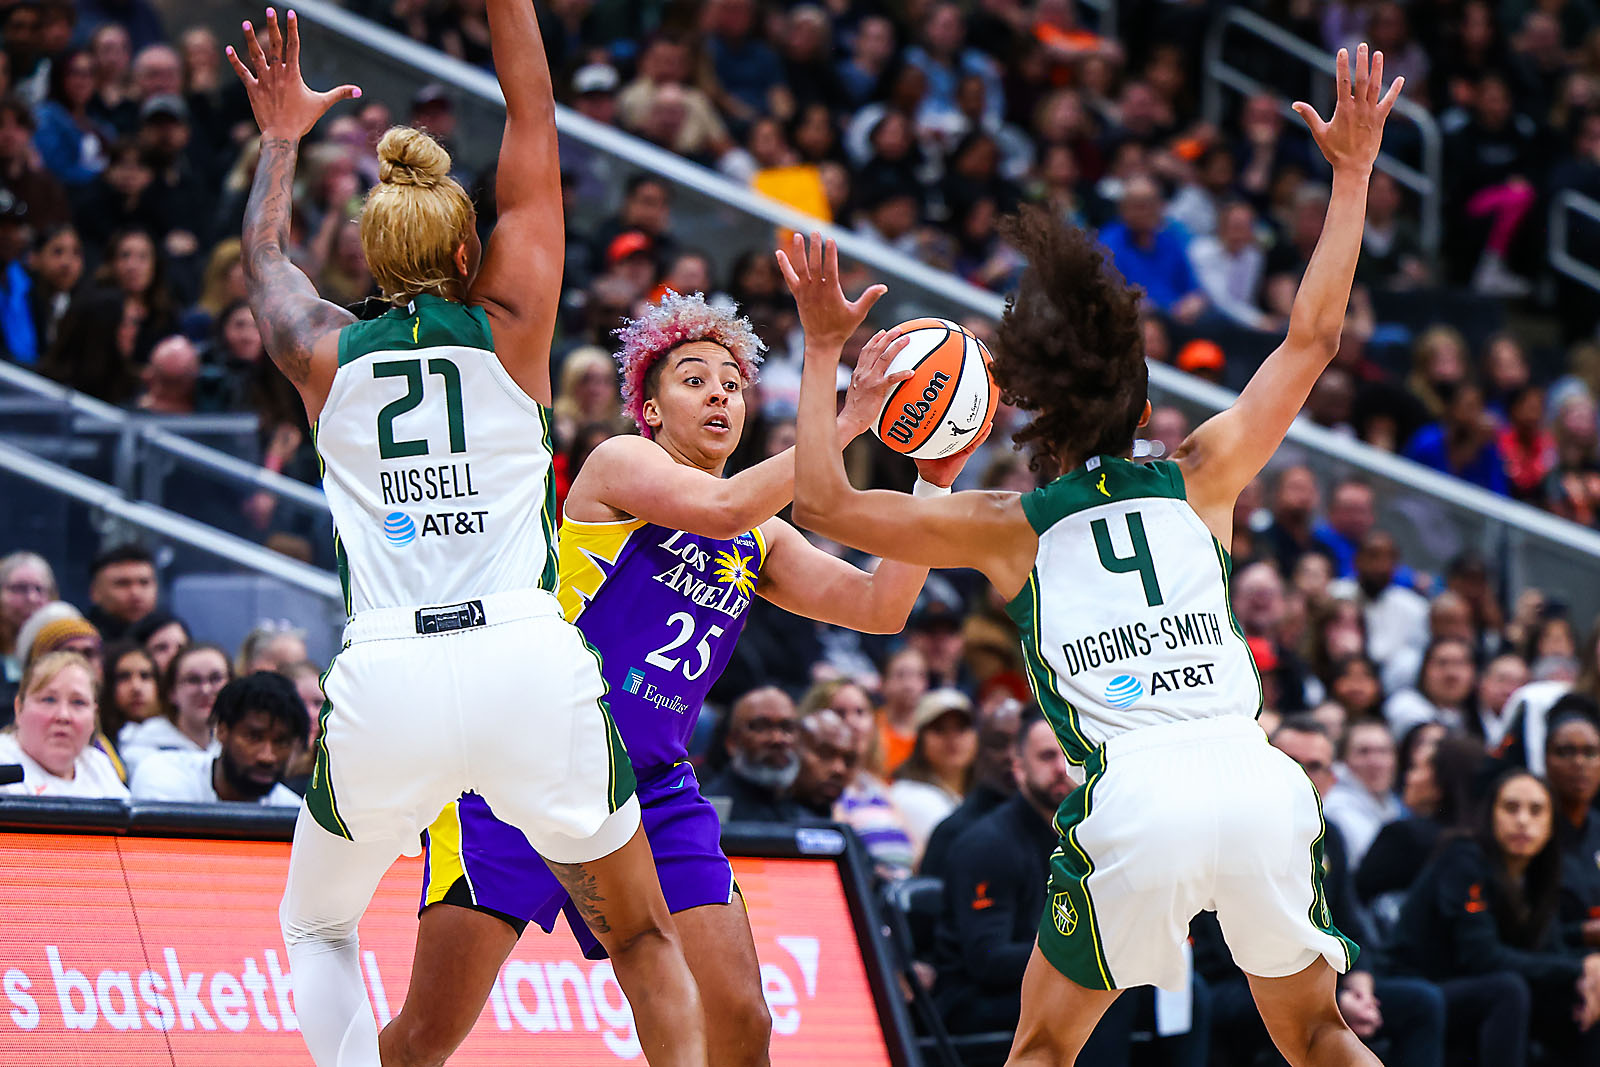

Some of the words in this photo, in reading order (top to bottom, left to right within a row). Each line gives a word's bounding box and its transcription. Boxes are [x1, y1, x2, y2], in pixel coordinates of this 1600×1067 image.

[373, 358, 467, 459] 21
[887, 370, 951, 444] Wilson
[380, 463, 479, 504] RUSSELL
[421, 511, 489, 537] AT&T
[658, 529, 711, 572] LOS
[1090, 511, 1164, 607] 4
[644, 611, 724, 680] 25
[1062, 613, 1223, 677] DIGGINS-SMITH
[1150, 663, 1214, 696] AT&T
[46, 945, 393, 1032] basketbl
